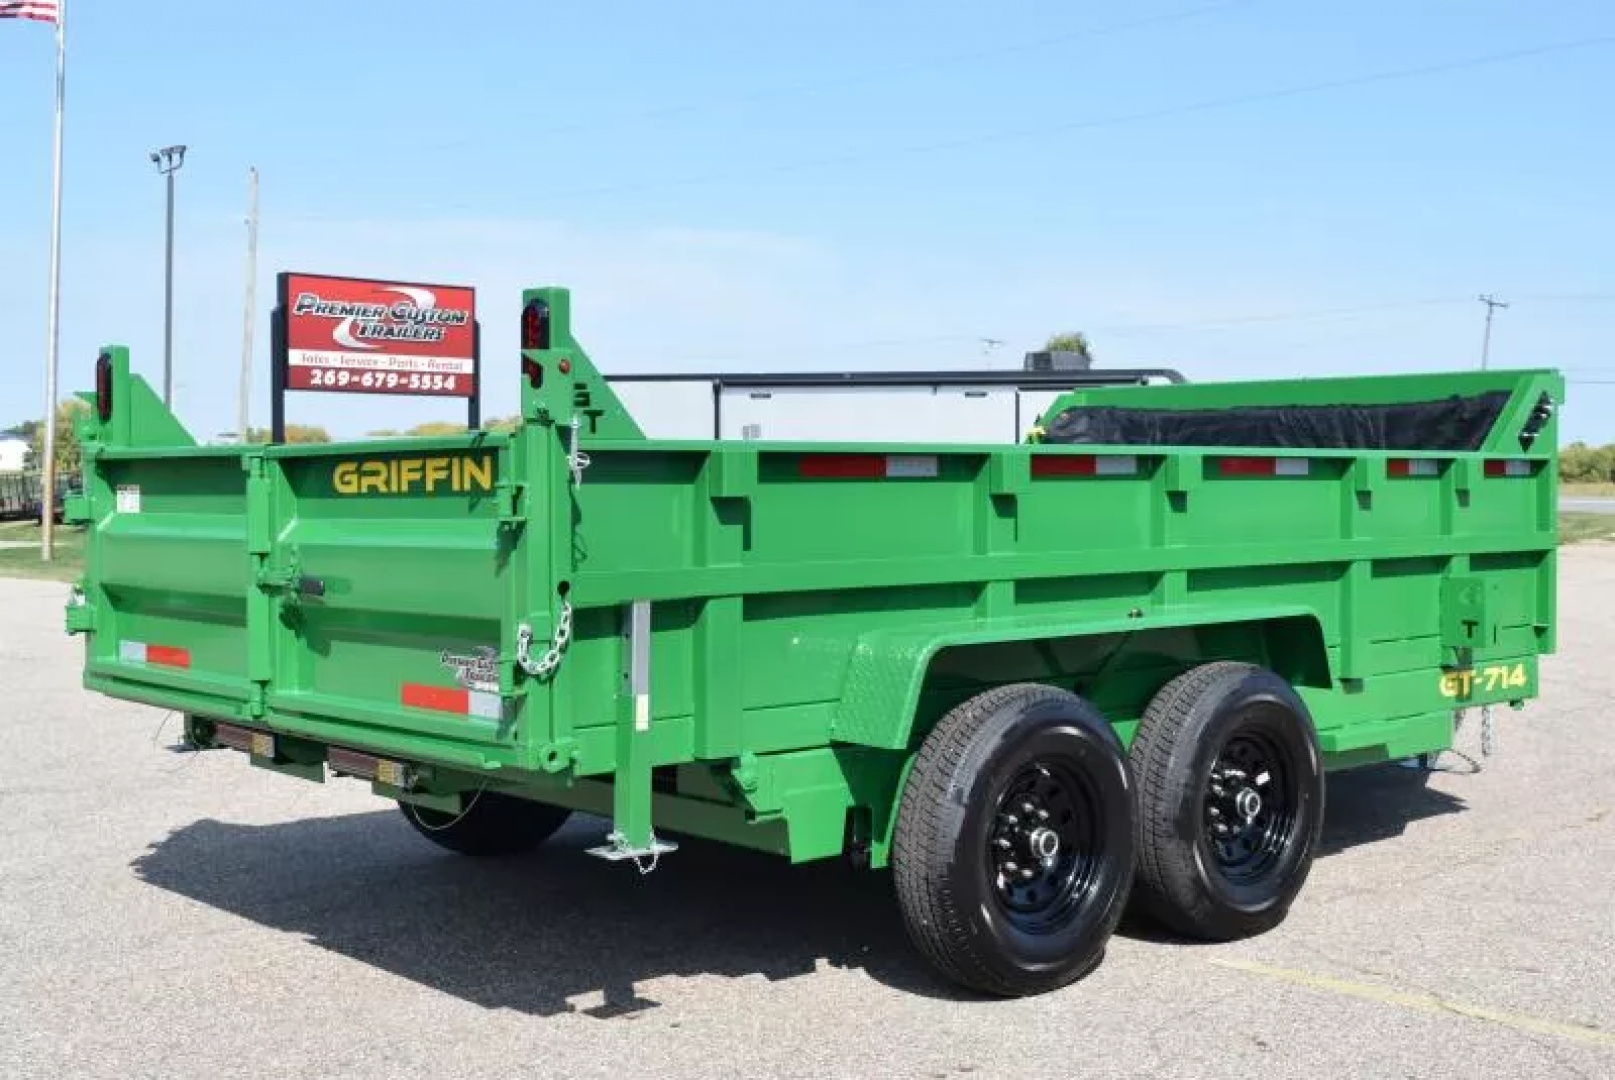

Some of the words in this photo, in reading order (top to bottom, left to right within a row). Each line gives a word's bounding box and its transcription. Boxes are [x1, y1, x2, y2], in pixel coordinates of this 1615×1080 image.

[309, 368, 456, 391] 269-679-5554
[333, 455, 492, 493] GRIFFIN
[1438, 663, 1527, 697] GT-714
